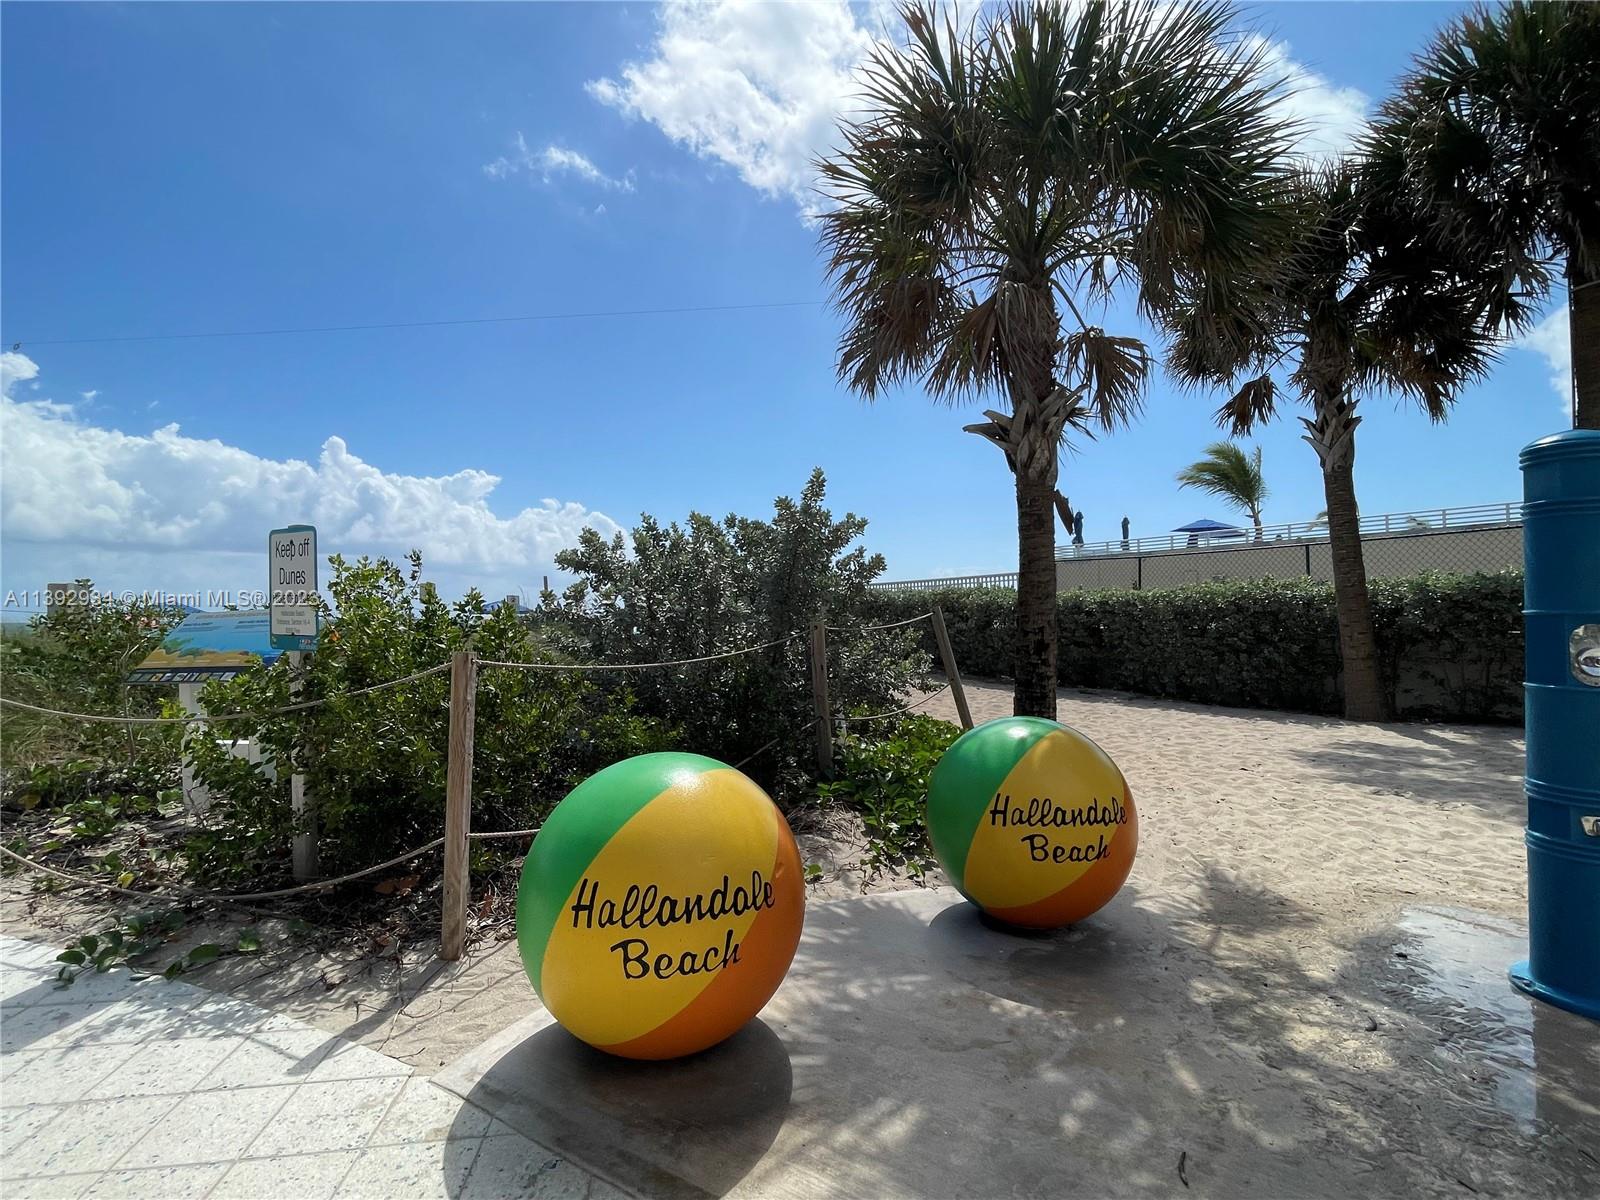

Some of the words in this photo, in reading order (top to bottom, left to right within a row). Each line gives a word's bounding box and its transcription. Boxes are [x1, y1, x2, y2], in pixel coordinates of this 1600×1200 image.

[275, 539, 296, 560] Keep
[298, 538, 310, 557] off
[279, 567, 306, 585] Dunes
[989, 793, 1128, 827] Hallandale
[1021, 833, 1111, 864] Beach
[571, 870, 776, 929] Hallandale
[610, 929, 741, 979] Beach
